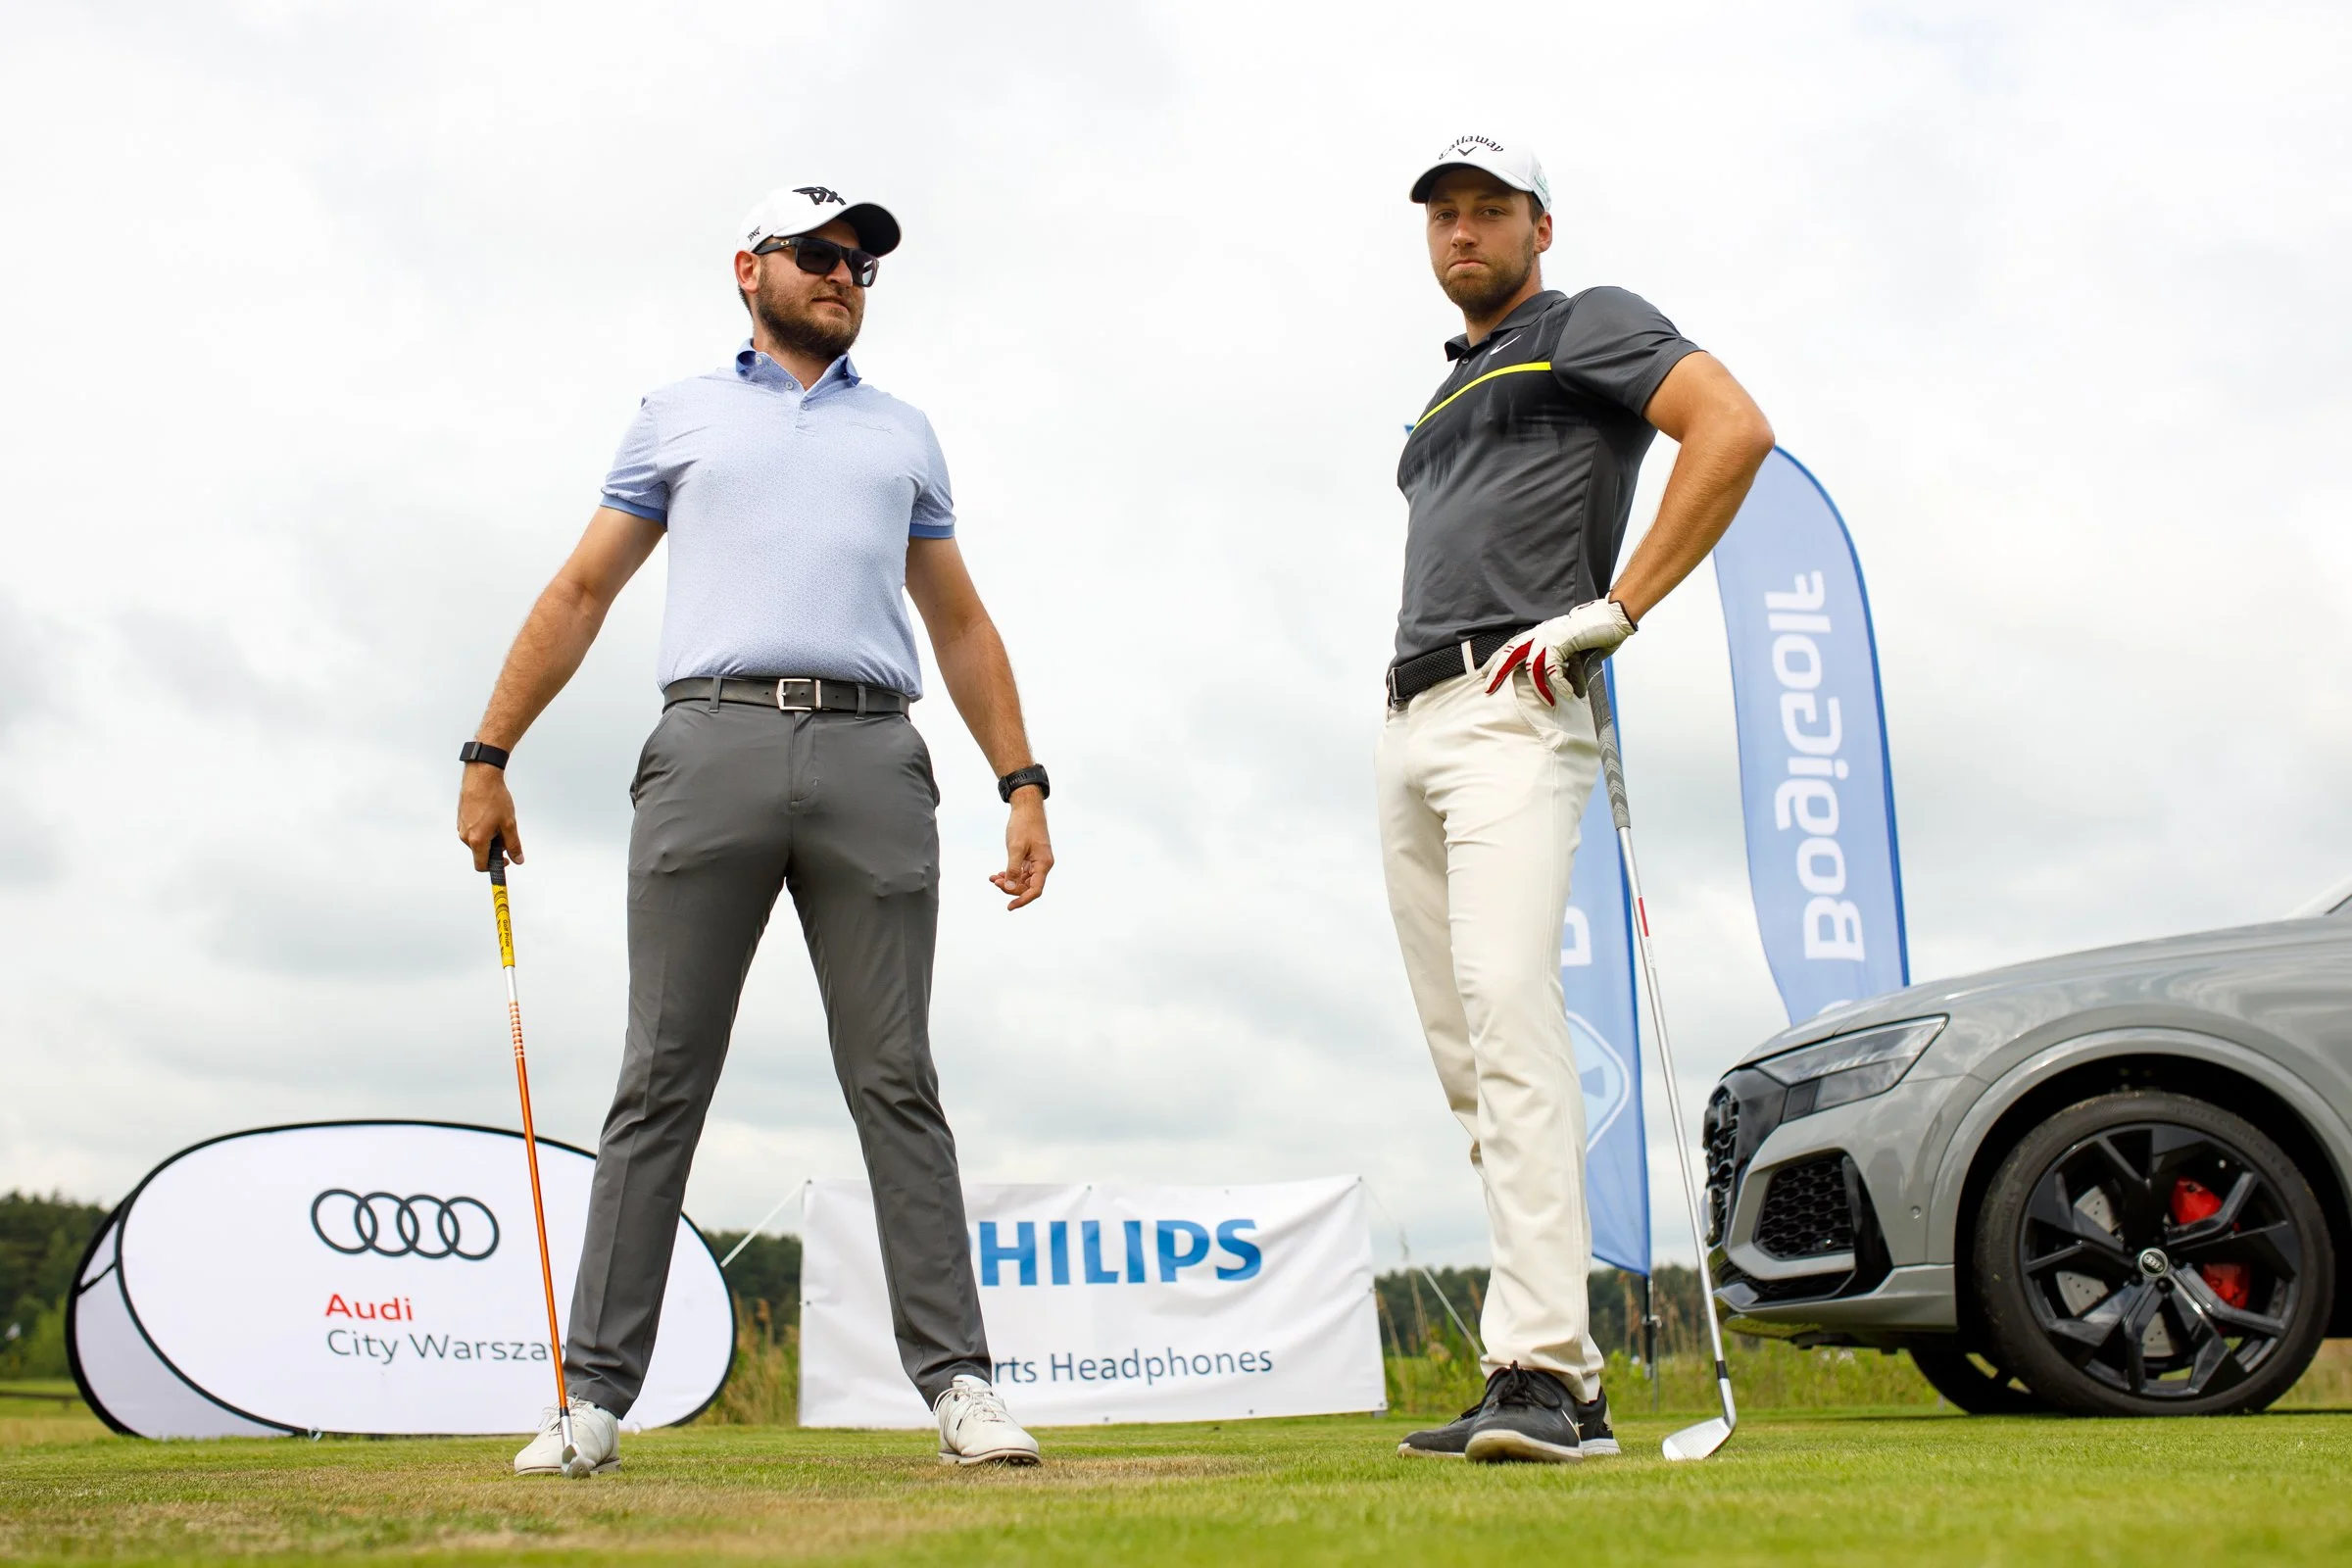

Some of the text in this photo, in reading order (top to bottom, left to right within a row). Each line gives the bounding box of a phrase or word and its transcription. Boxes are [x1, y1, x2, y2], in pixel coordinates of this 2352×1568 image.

[1439, 134, 1504, 161] Callaway
[968, 1218, 1264, 1288] HILIPS
[324, 1293, 413, 1322] Audi
[326, 1329, 566, 1365] City Warsza
[994, 1347, 1274, 1386] rts Headphones
